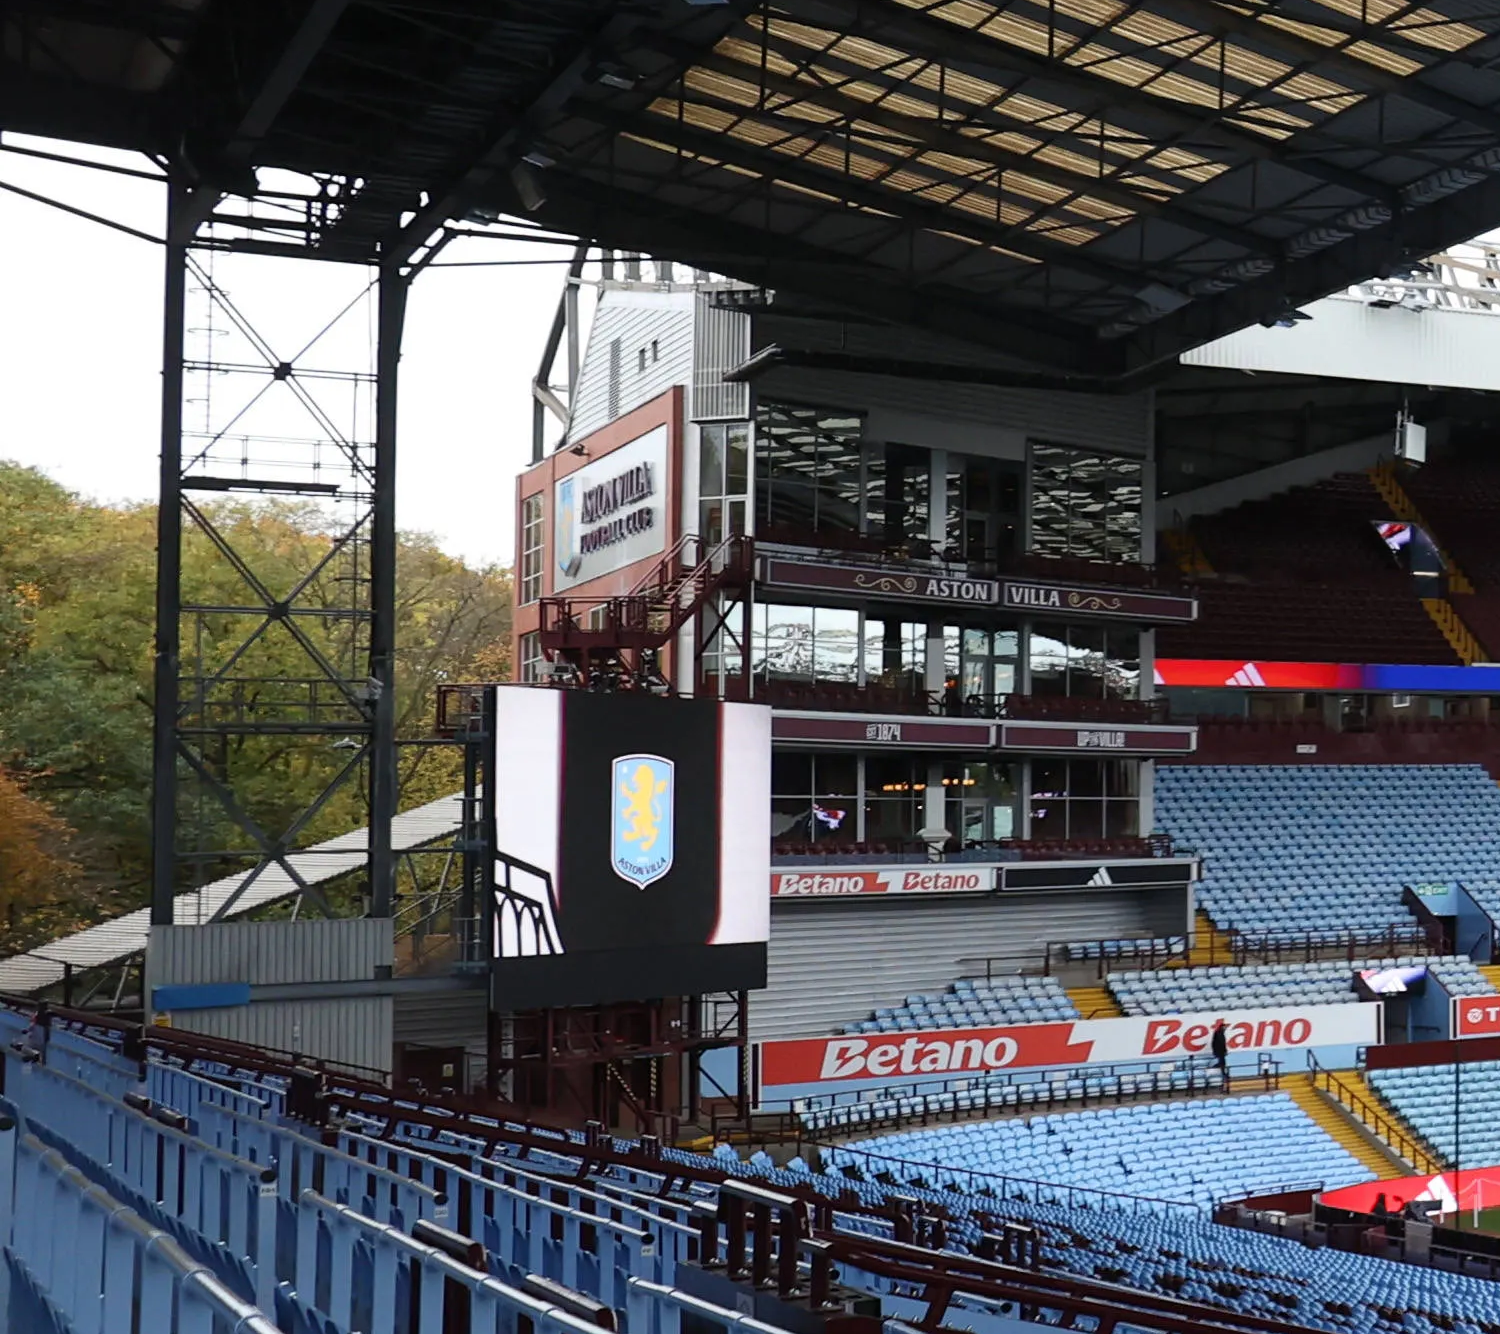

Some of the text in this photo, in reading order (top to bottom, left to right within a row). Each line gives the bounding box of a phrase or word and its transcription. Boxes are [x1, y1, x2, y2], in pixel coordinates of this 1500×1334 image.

[925, 579, 1061, 607] ASTON VILLA
[877, 723, 901, 741] 1874
[618, 857, 644, 875] ASTON
[645, 856, 667, 875] VILLA
[777, 871, 979, 895] Betano Betano
[820, 1036, 1019, 1079] Betano
